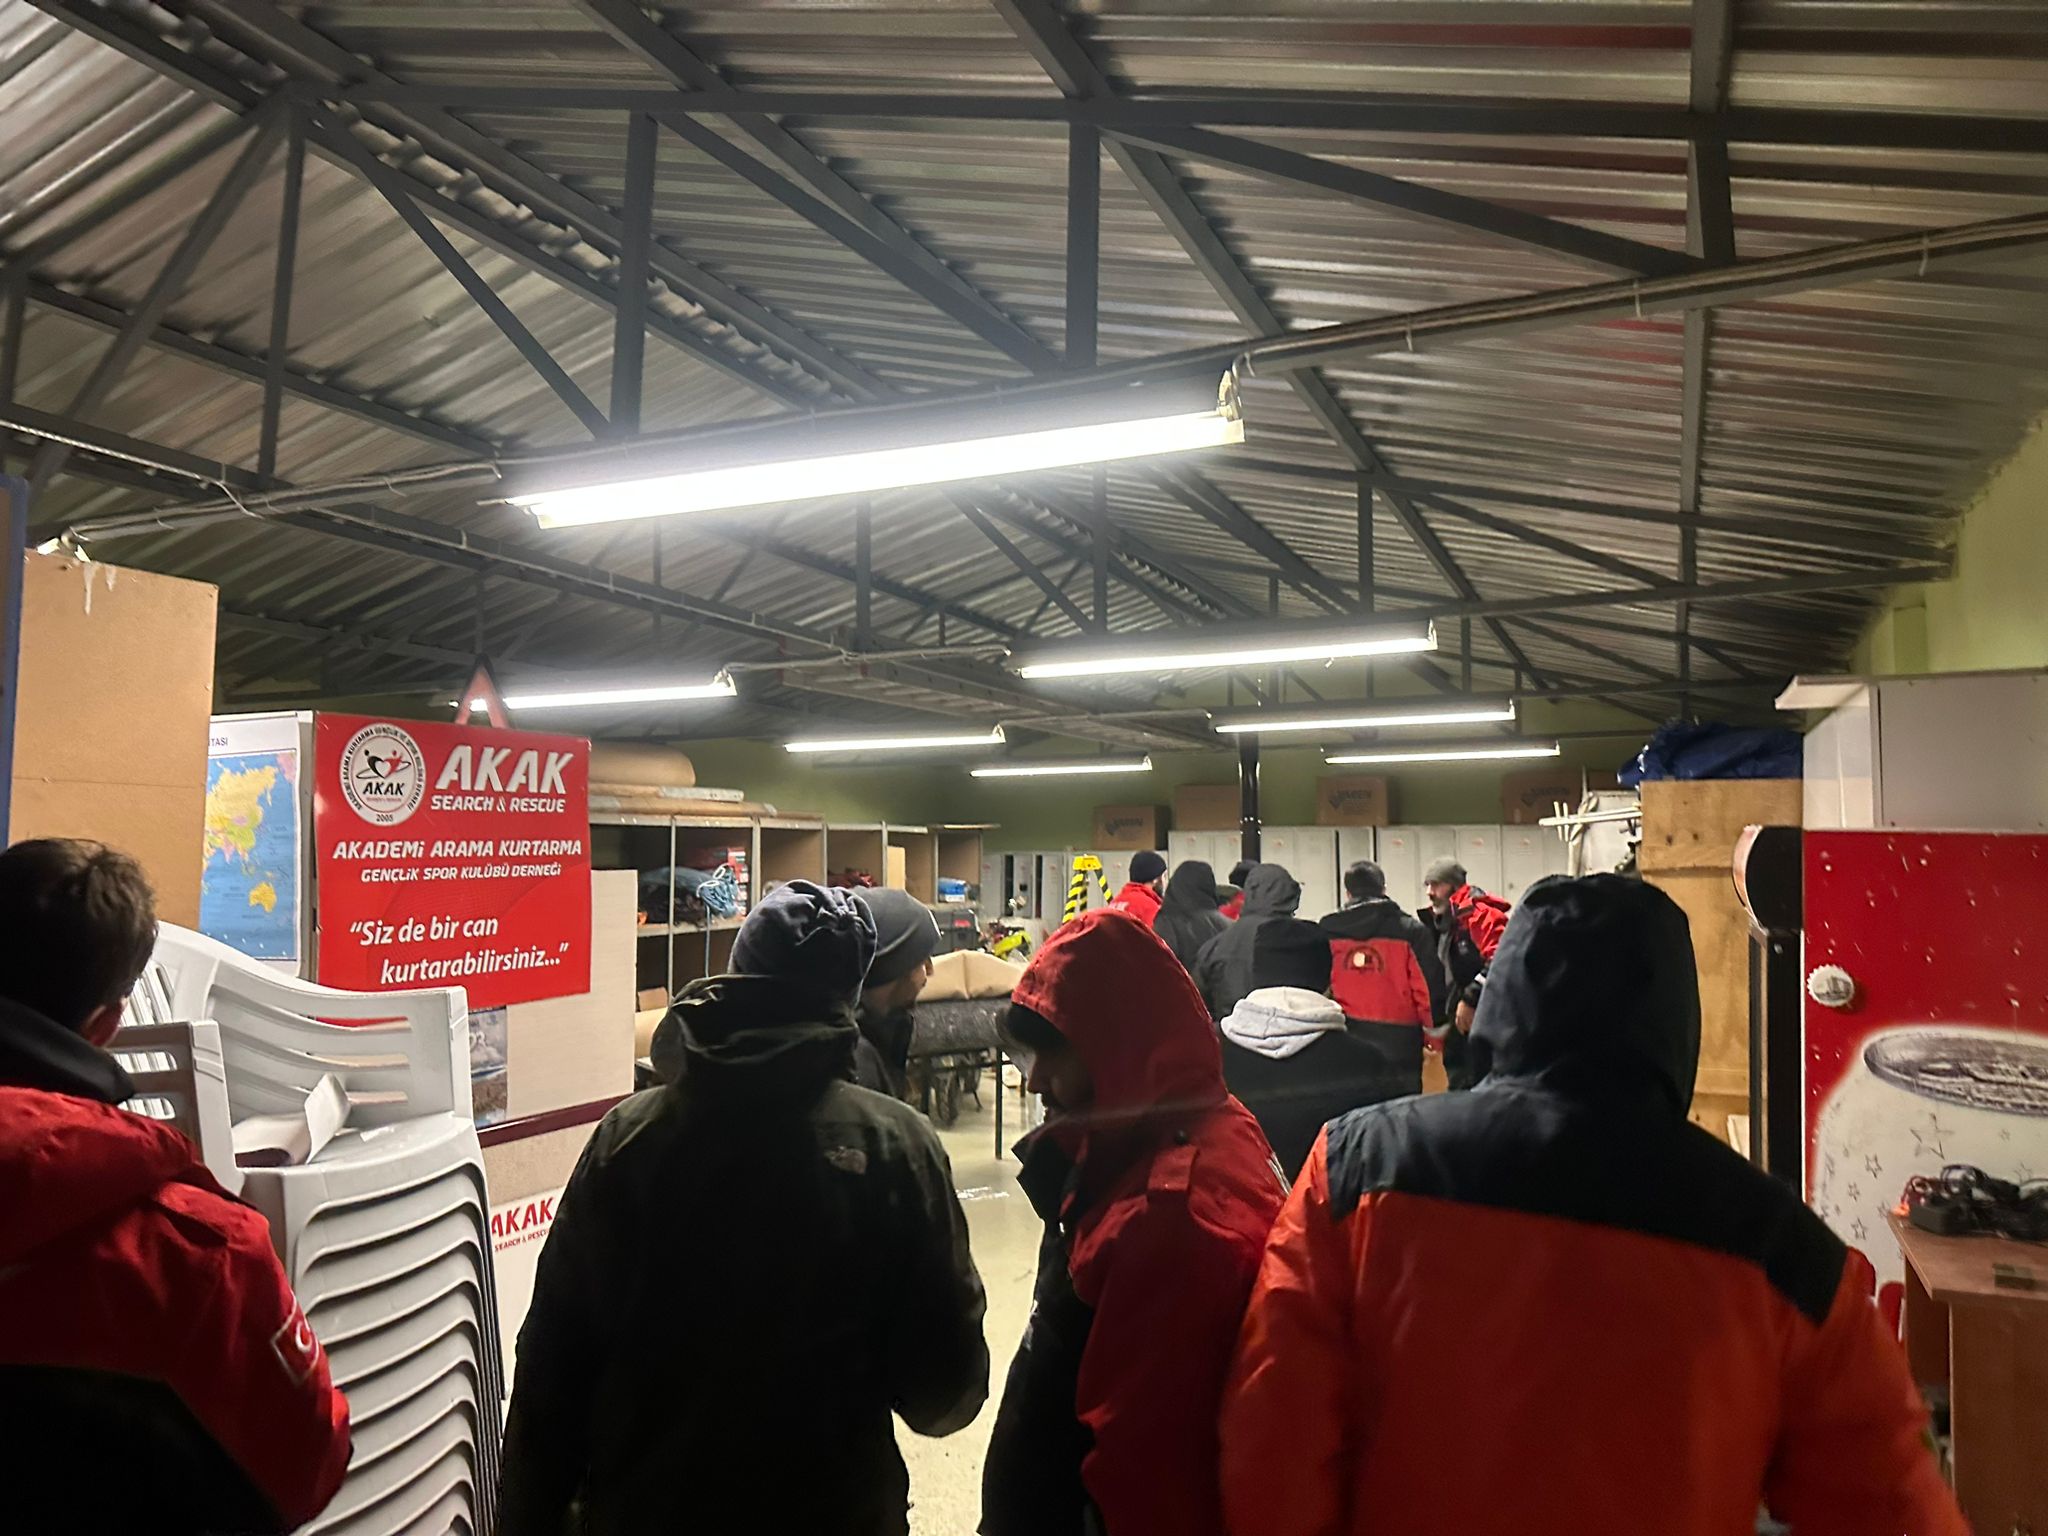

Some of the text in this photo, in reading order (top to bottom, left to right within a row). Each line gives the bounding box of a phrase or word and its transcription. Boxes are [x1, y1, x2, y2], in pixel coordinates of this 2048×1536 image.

[435, 745, 574, 794] AKAK
[363, 782, 405, 796] AKAK
[431, 795, 566, 813] SEARCH & RESCUE
[430, 841, 494, 858] ARAMA
[498, 840, 582, 857] KURTARMA
[423, 867, 457, 880] SPOR
[461, 863, 509, 879] KULÜBÜ
[398, 917, 426, 943] de
[429, 915, 460, 940] bir
[462, 917, 498, 938] can
[491, 1197, 553, 1237] AKAK
